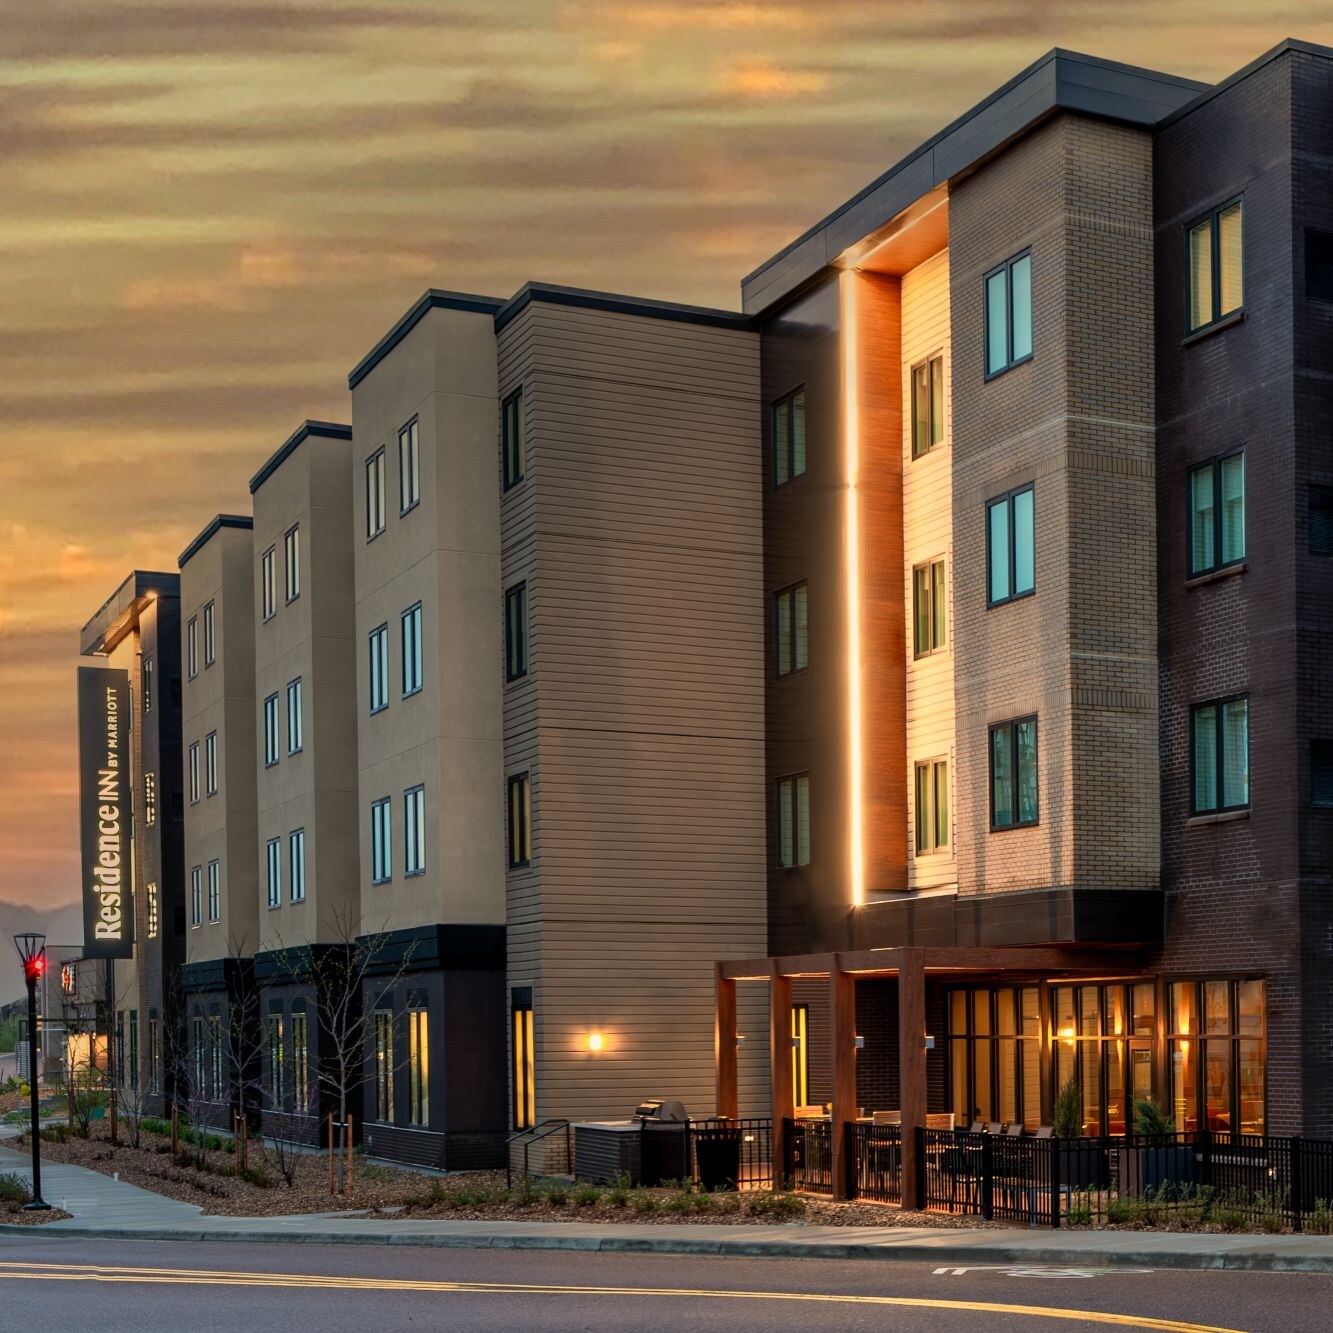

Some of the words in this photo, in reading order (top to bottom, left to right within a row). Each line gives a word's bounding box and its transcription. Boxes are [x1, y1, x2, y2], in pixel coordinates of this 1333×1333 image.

[106, 687, 119, 749] MARRIOTT
[107, 751, 119, 768] BY
[98, 770, 120, 801] INN
[94, 804, 122, 941] Residence
